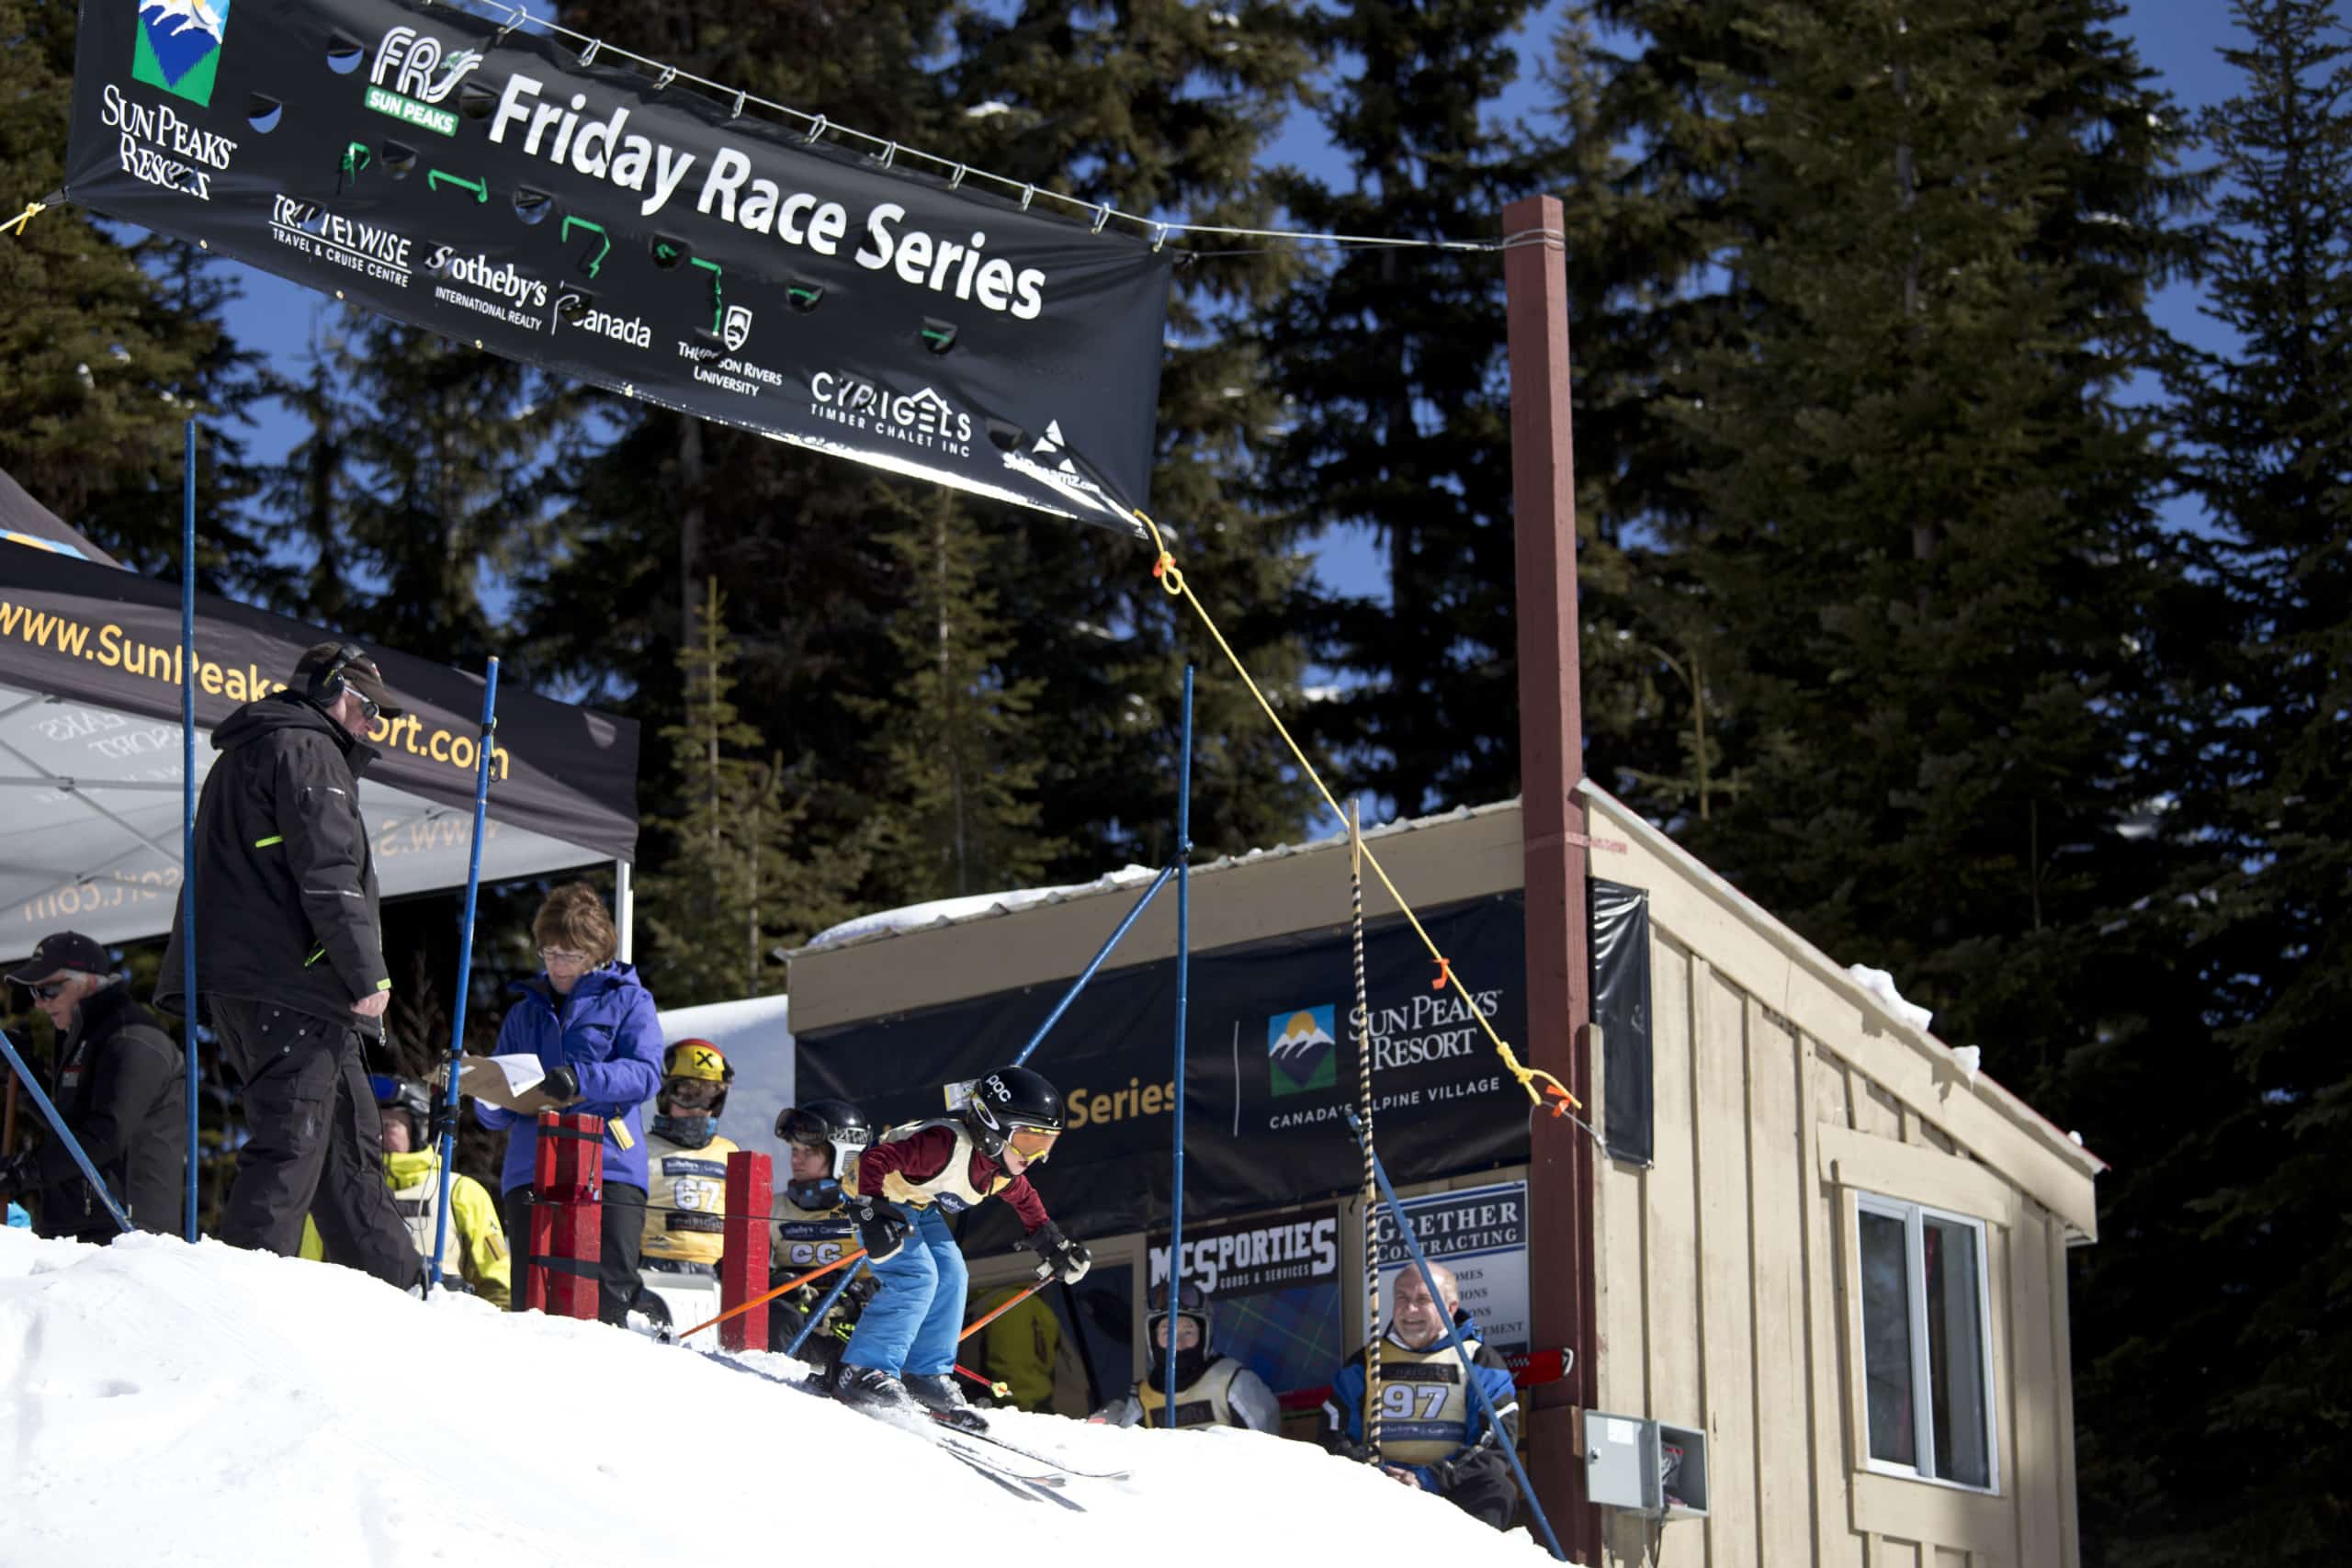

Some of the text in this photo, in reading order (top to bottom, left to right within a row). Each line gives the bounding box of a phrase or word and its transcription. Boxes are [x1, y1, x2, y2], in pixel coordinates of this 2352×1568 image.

[369, 91, 455, 134] SUN PEAKS
[488, 73, 1046, 321] Friday Race Series
[273, 228, 410, 288] TRAVEL & CRUISE CENTRE
[424, 245, 548, 308] Sotheby's
[435, 286, 543, 332] INTERNATIONAL REALTY
[694, 366, 760, 397] UNIVERSITY
[744, 361, 783, 386] RIVERS
[810, 403, 970, 457] TIMBER CHALET INC
[1373, 1027, 1478, 1071] RESORT
[1067, 1077, 1175, 1130] Series
[1372, 1090, 1420, 1112] LPINE
[1427, 1077, 1500, 1102] VILLAGE
[674, 1178, 721, 1213] 67
[1381, 1382, 1450, 1419] 97
